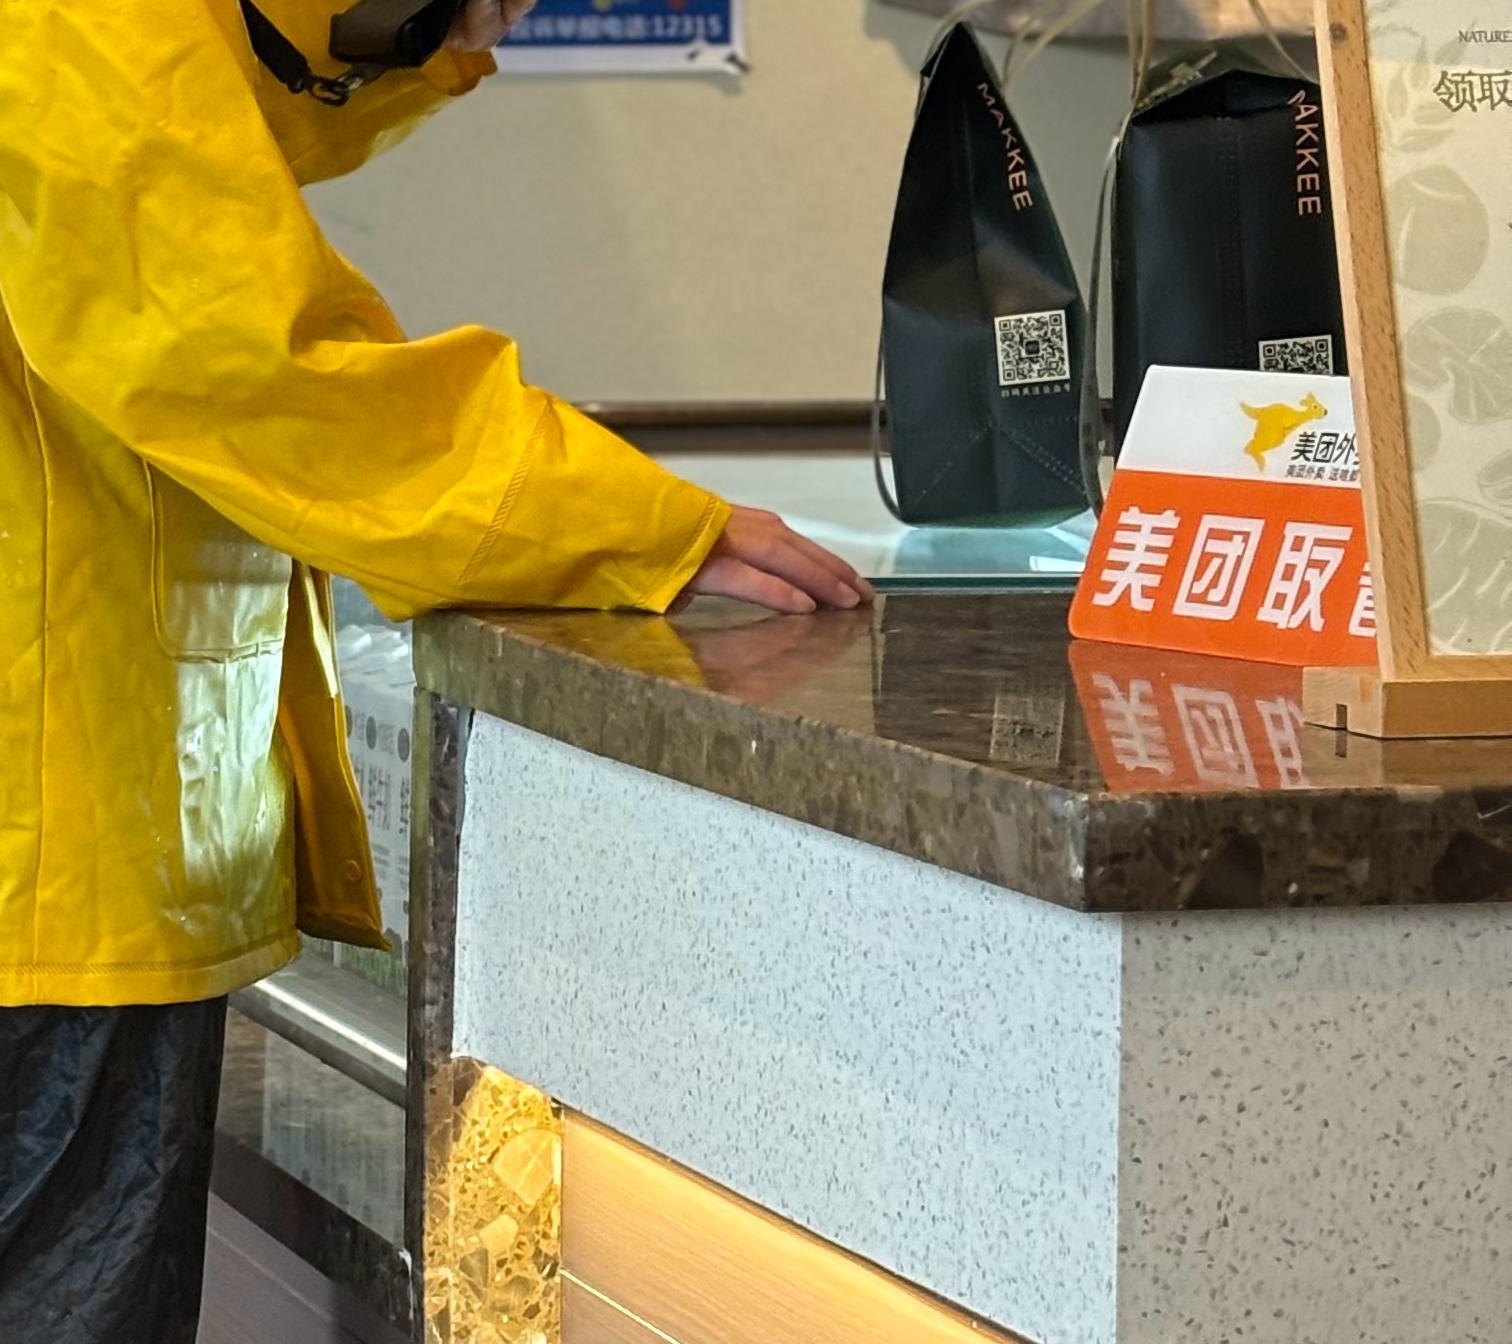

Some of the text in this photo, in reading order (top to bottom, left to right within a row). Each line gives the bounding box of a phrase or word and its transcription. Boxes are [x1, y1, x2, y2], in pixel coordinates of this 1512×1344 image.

[976, 81, 1034, 211] MAKKEE
[1290, 431, 1360, 465] 美团外
